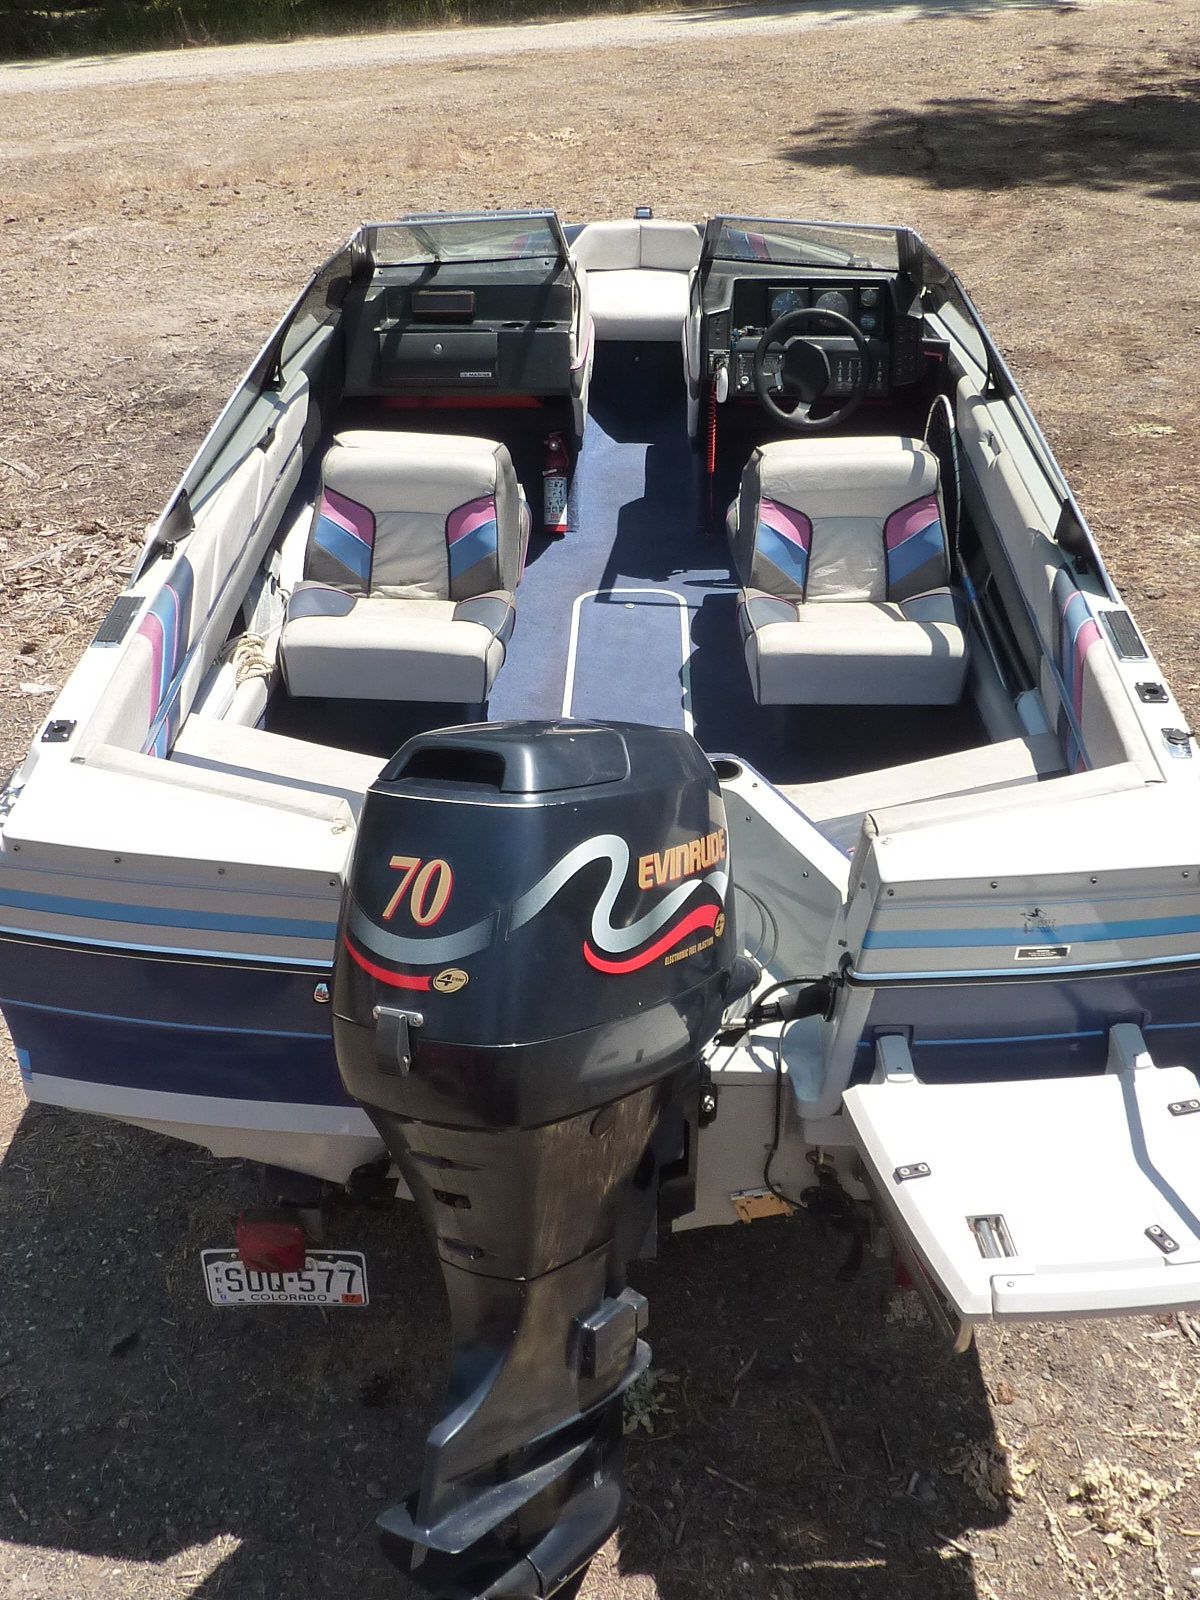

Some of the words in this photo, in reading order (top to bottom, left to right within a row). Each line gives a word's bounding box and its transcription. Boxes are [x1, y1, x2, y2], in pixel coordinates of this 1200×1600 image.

[382, 855, 454, 927] 70
[637, 828, 726, 892] EVINRUDE
[250, 1293, 328, 1302] COLORADO
